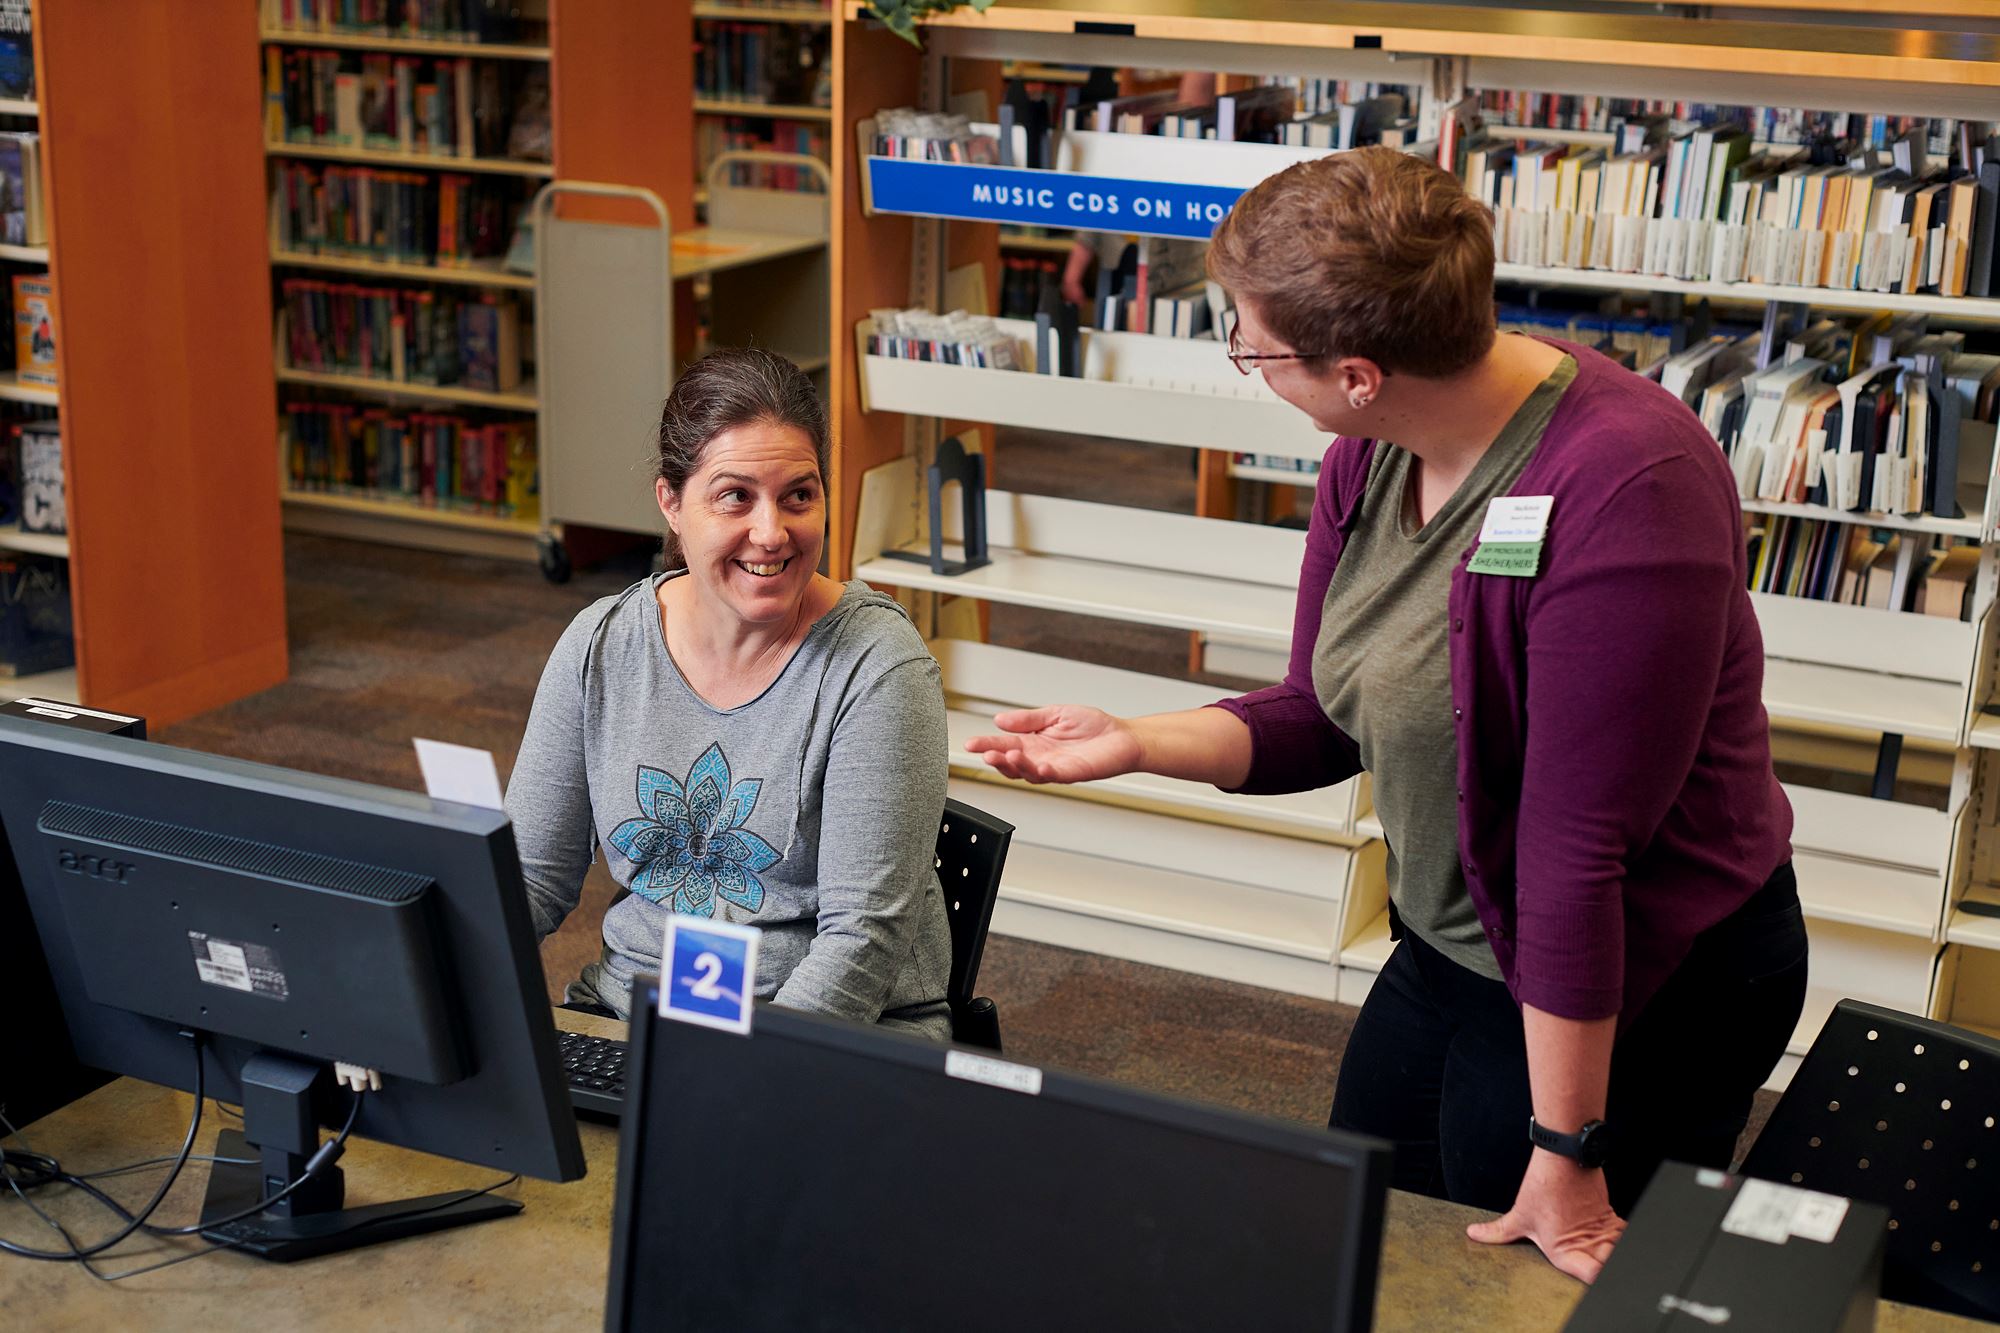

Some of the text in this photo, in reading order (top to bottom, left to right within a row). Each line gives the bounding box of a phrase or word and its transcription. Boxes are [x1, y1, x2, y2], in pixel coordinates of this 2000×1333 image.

[973, 184, 1054, 209] MUSIC
[1067, 192, 1119, 214] CDS
[1132, 197, 1171, 219] ON
[59, 850, 136, 885] acer
[690, 951, 723, 1001] 2
